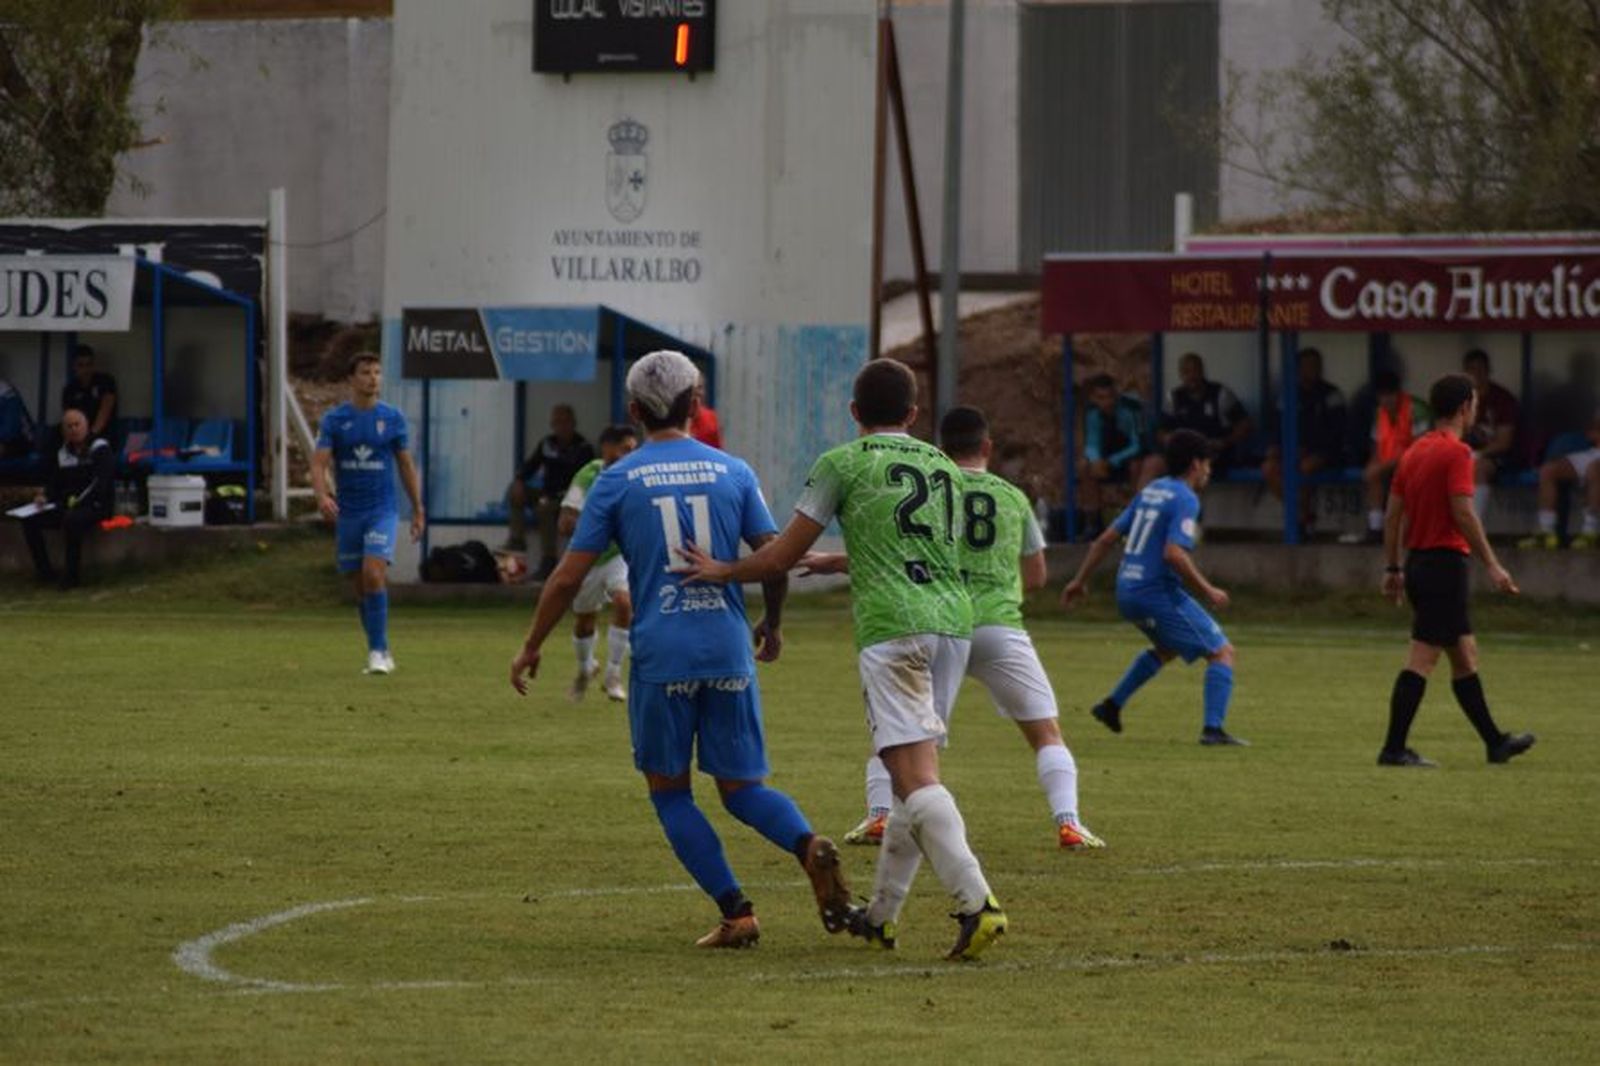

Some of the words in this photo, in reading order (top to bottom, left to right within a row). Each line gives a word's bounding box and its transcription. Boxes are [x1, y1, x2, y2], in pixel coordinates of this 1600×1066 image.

[675, 22, 690, 65] 1
[552, 229, 675, 247] AYUNTAMIENTO
[679, 231, 702, 249] DE
[551, 255, 702, 284] VILLARALBO
[1170, 271, 1233, 296] HOTEL
[1170, 301, 1311, 328] RESTAURANTE
[1320, 266, 1436, 320] Casa
[886, 463, 954, 545] 21
[963, 490, 997, 552] 8
[652, 494, 713, 573] 11
[1124, 508, 1160, 555] 17
